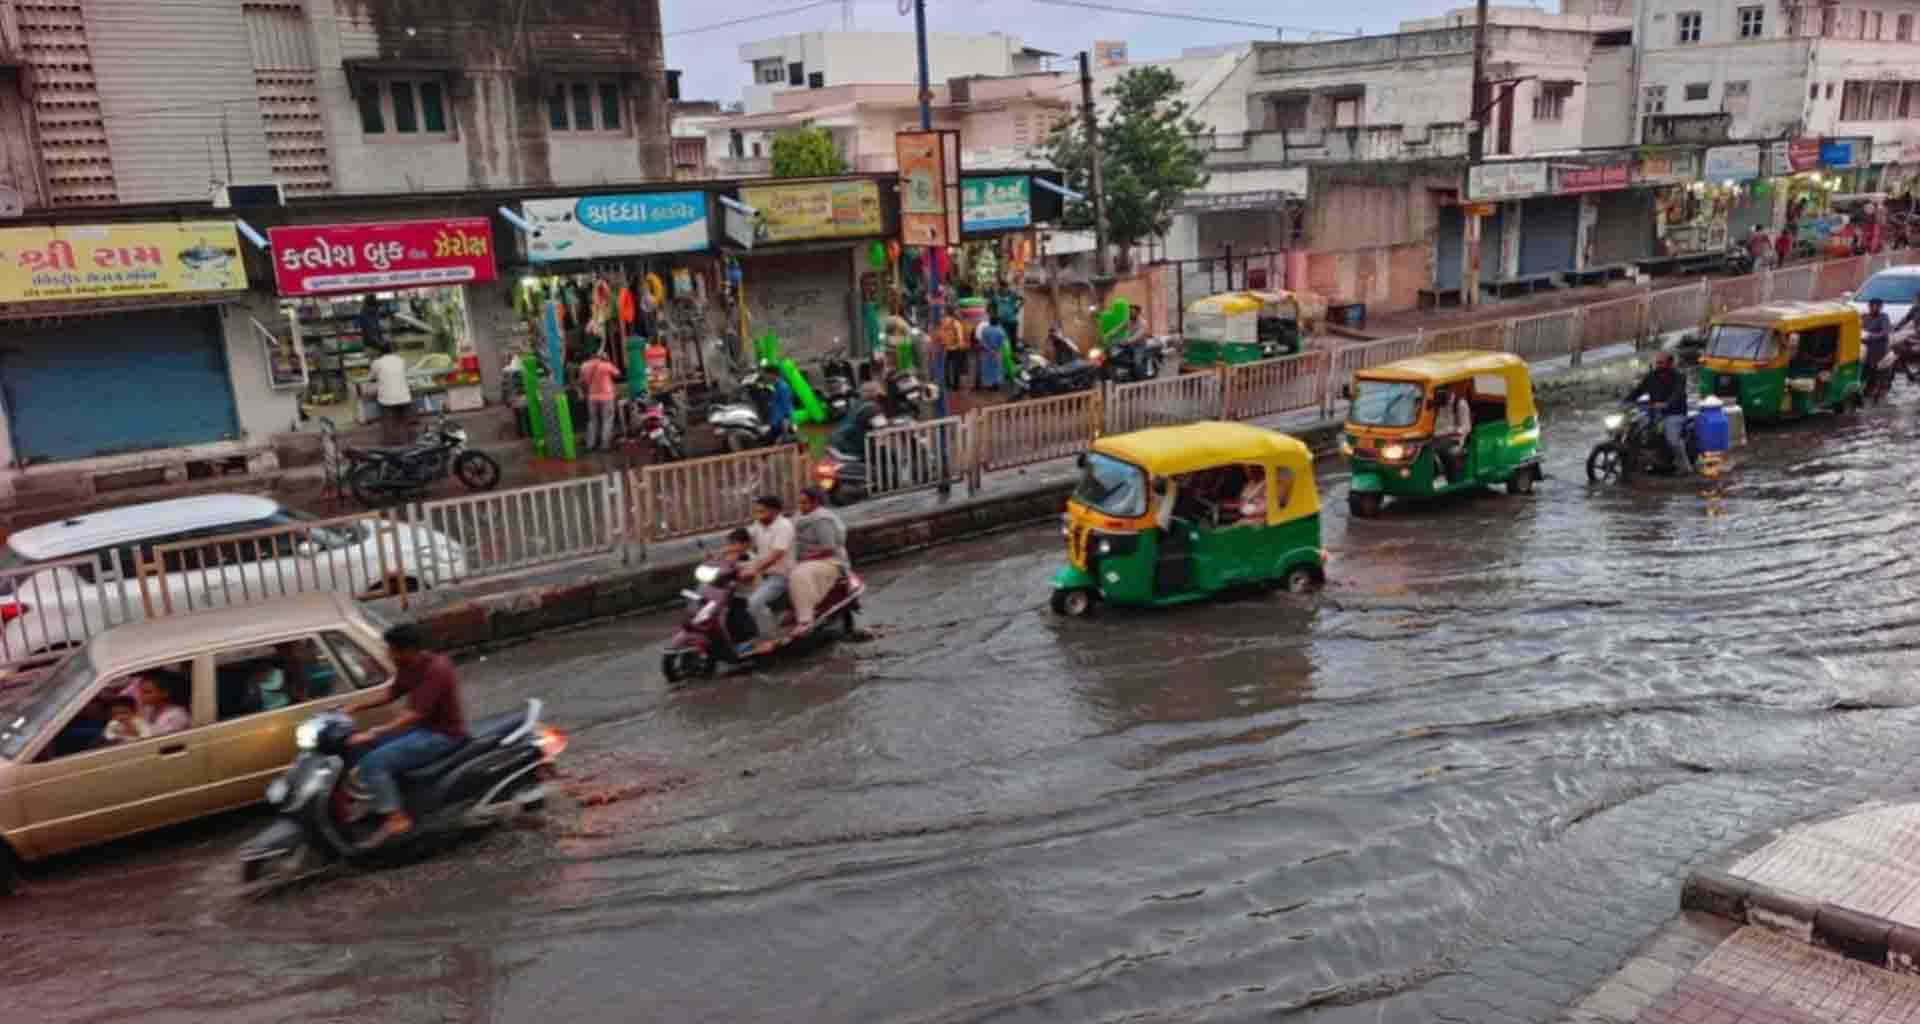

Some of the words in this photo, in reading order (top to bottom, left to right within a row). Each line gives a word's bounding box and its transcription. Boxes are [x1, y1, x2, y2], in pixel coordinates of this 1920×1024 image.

[17, 239, 77, 273] શ્રી
[94, 242, 163, 270] રામ
[363, 240, 404, 270] બુક
